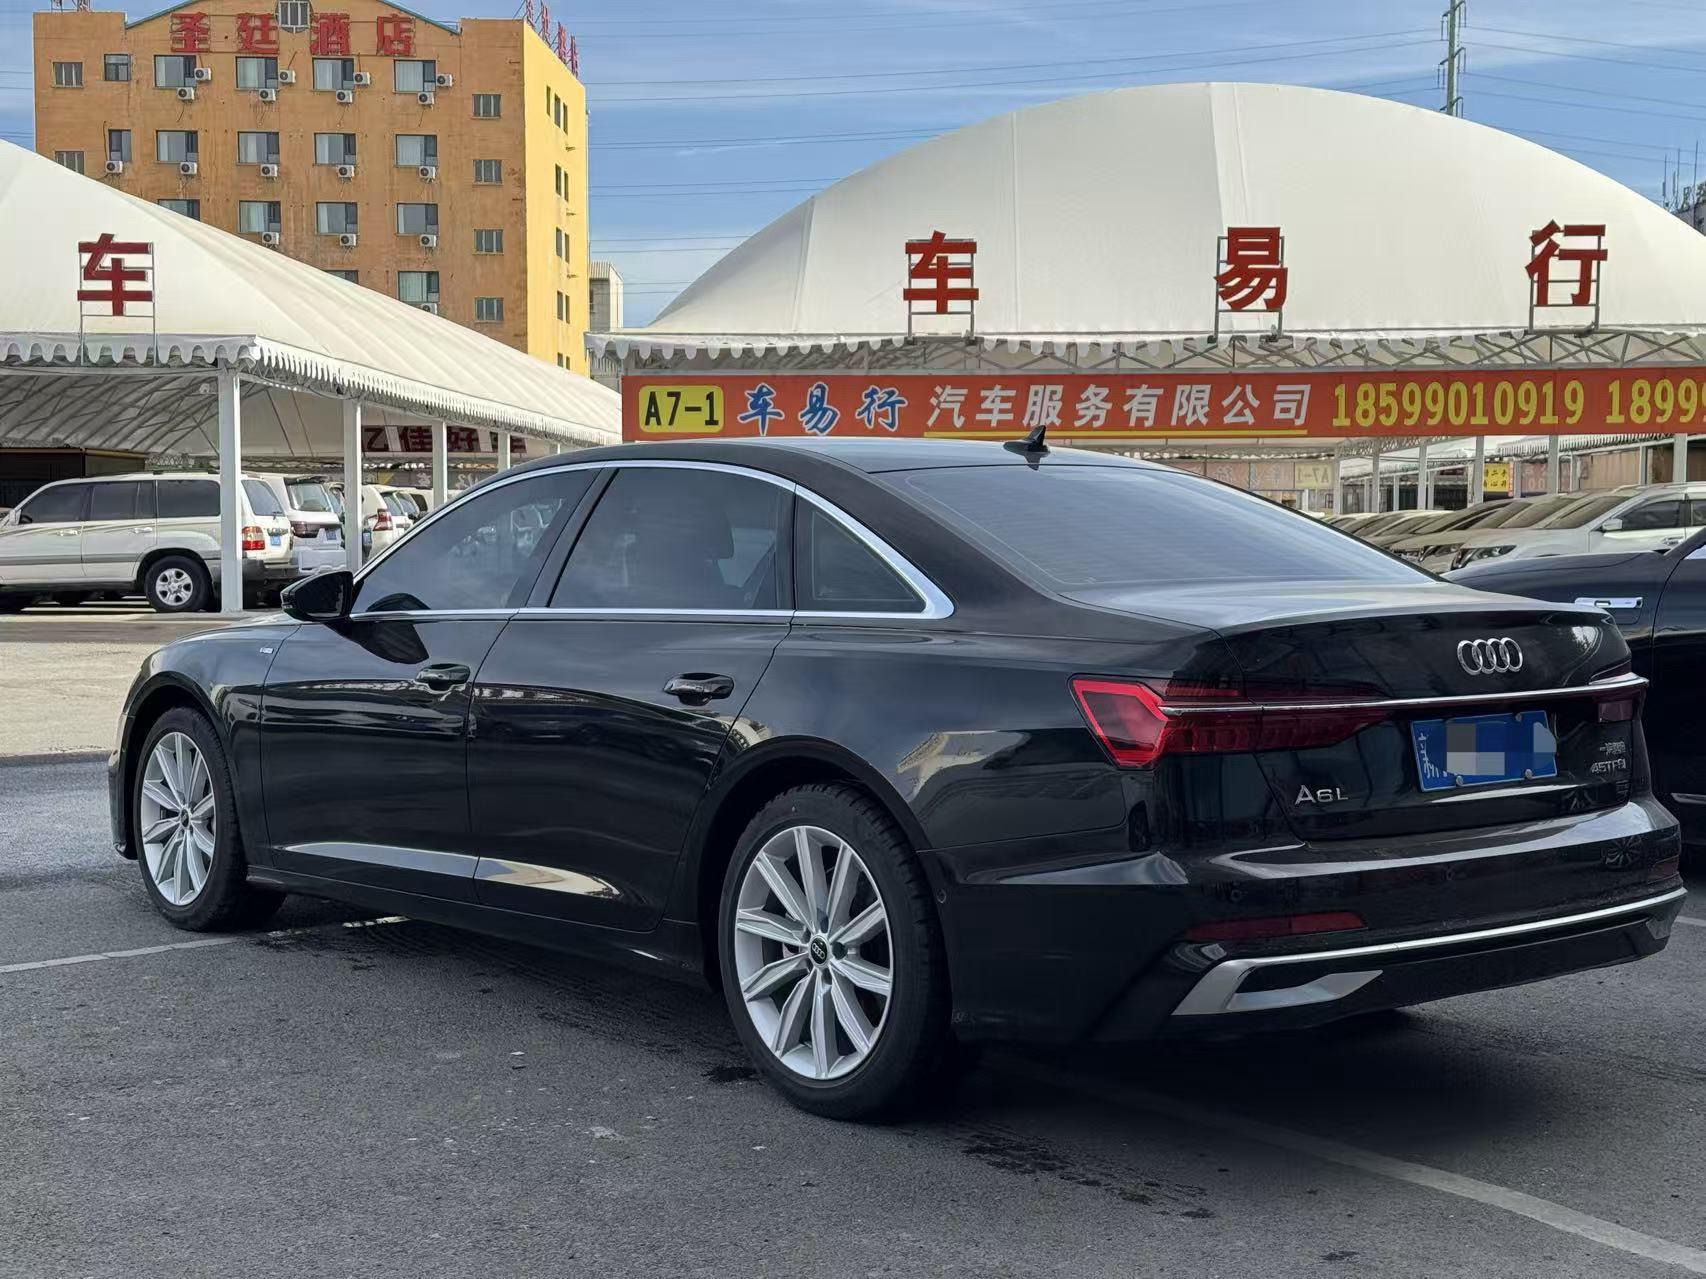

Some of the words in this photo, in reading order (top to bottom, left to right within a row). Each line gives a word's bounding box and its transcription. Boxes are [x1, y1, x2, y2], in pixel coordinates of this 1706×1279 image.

[170, 12, 417, 56] 圣廷酒店
[77, 232, 153, 316] 车
[644, 391, 719, 426] A7-1
[738, 382, 908, 437] 车易行
[926, 383, 1312, 428] 汽车服务有限公司
[1332, 380, 1584, 428] 18599010919
[1605, 378, 1706, 425] 1899
[1294, 784, 1349, 806] A6L
